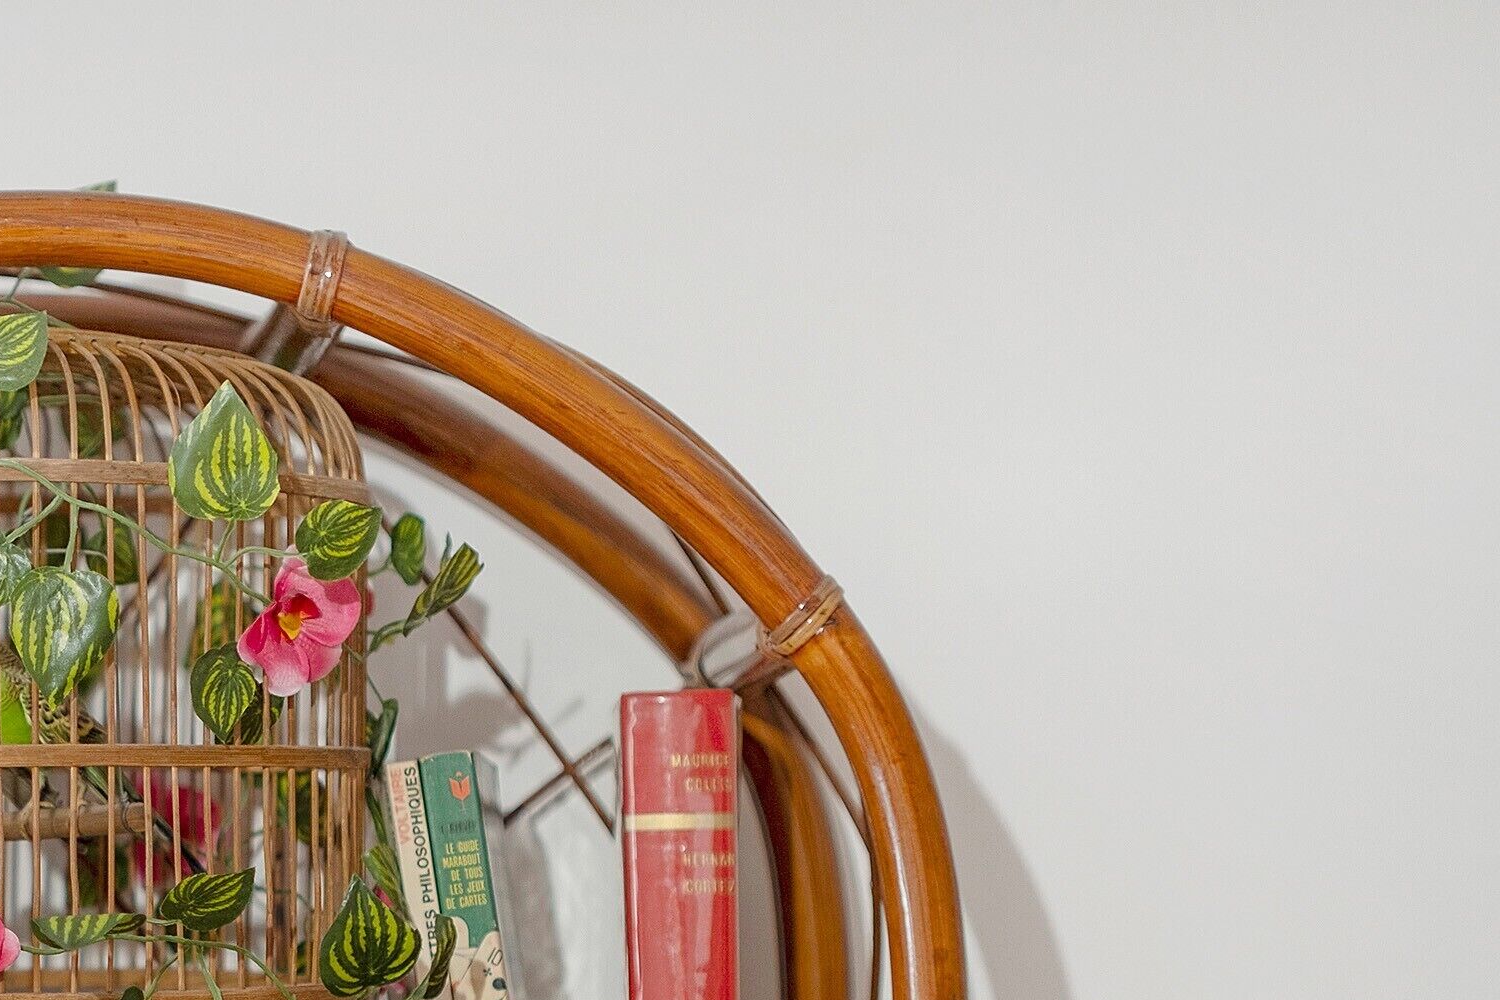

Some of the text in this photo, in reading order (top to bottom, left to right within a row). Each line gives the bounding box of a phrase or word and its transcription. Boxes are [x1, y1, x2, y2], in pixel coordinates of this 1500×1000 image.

[670, 752, 729, 769] MAURICE
[390, 767, 411, 845] VOLTAIRE
[405, 766, 434, 903] PHILOSOPHIQUES
[446, 840, 479, 855] LE GUIDE
[442, 854, 480, 869] MARABOUT
[451, 866, 483, 881] DE TOUS
[450, 880, 485, 895] LES JEUX
[446, 893, 487, 910] DE CARTES
